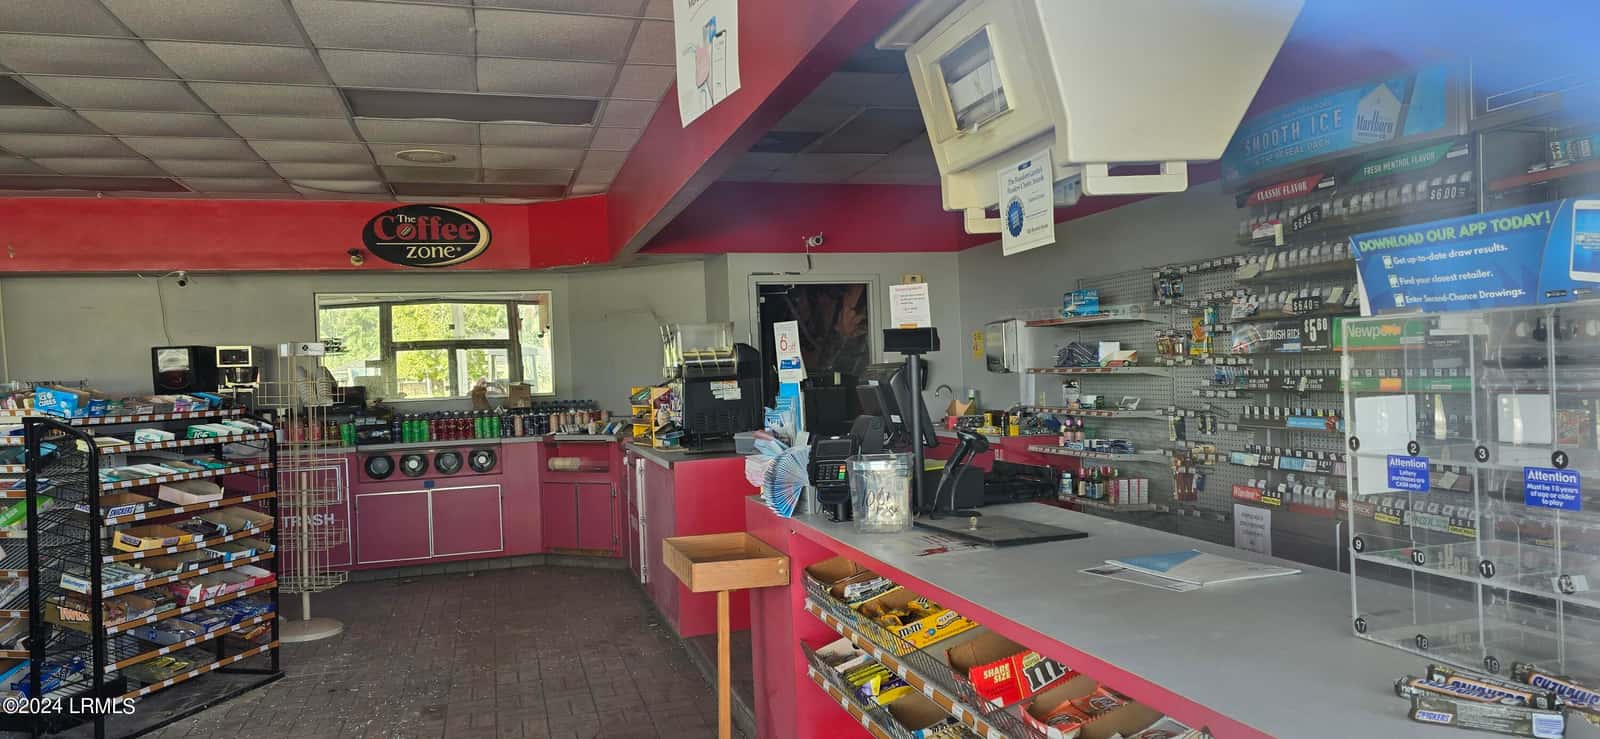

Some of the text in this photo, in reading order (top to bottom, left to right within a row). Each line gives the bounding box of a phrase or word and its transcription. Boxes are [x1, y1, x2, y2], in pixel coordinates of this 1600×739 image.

[1356, 111, 1394, 133] Marlboro
[1244, 109, 1342, 156] SMOOTH ICE
[1364, 151, 1435, 176] FRESH MENTHOL FLAVOR
[1257, 181, 1308, 201] CLASSIC FLAVOR
[397, 214, 416, 224] The
[373, 215, 476, 242] Coffee
[1358, 210, 1551, 252] DOWNLOAD OUR APP TODAY!
[1393, 243, 1508, 265] Get up-to-date draw results.
[1399, 269, 1494, 287] Find your closest retailer.
[1405, 287, 1526, 304] Enter Second-Chance Drawings.
[780, 335, 788, 352] 6
[1389, 458, 1427, 470] Attention
[1527, 470, 1577, 485] Attention
[1527, 483, 1541, 491] Must
[1560, 486, 1578, 495] years
[1538, 491, 1548, 500] age
[1557, 492, 1576, 501] older
[1549, 499, 1564, 508] play
[110, 504, 135, 519] SNICKERS
[1412, 552, 1424, 563] 10
[1481, 563, 1494, 575] 11
[1355, 620, 1367, 631] 17
[1416, 635, 1428, 649] 18
[983, 662, 1010, 680] SHARE
[1486, 658, 1499, 672] 19
[993, 672, 1011, 685] SIZE
